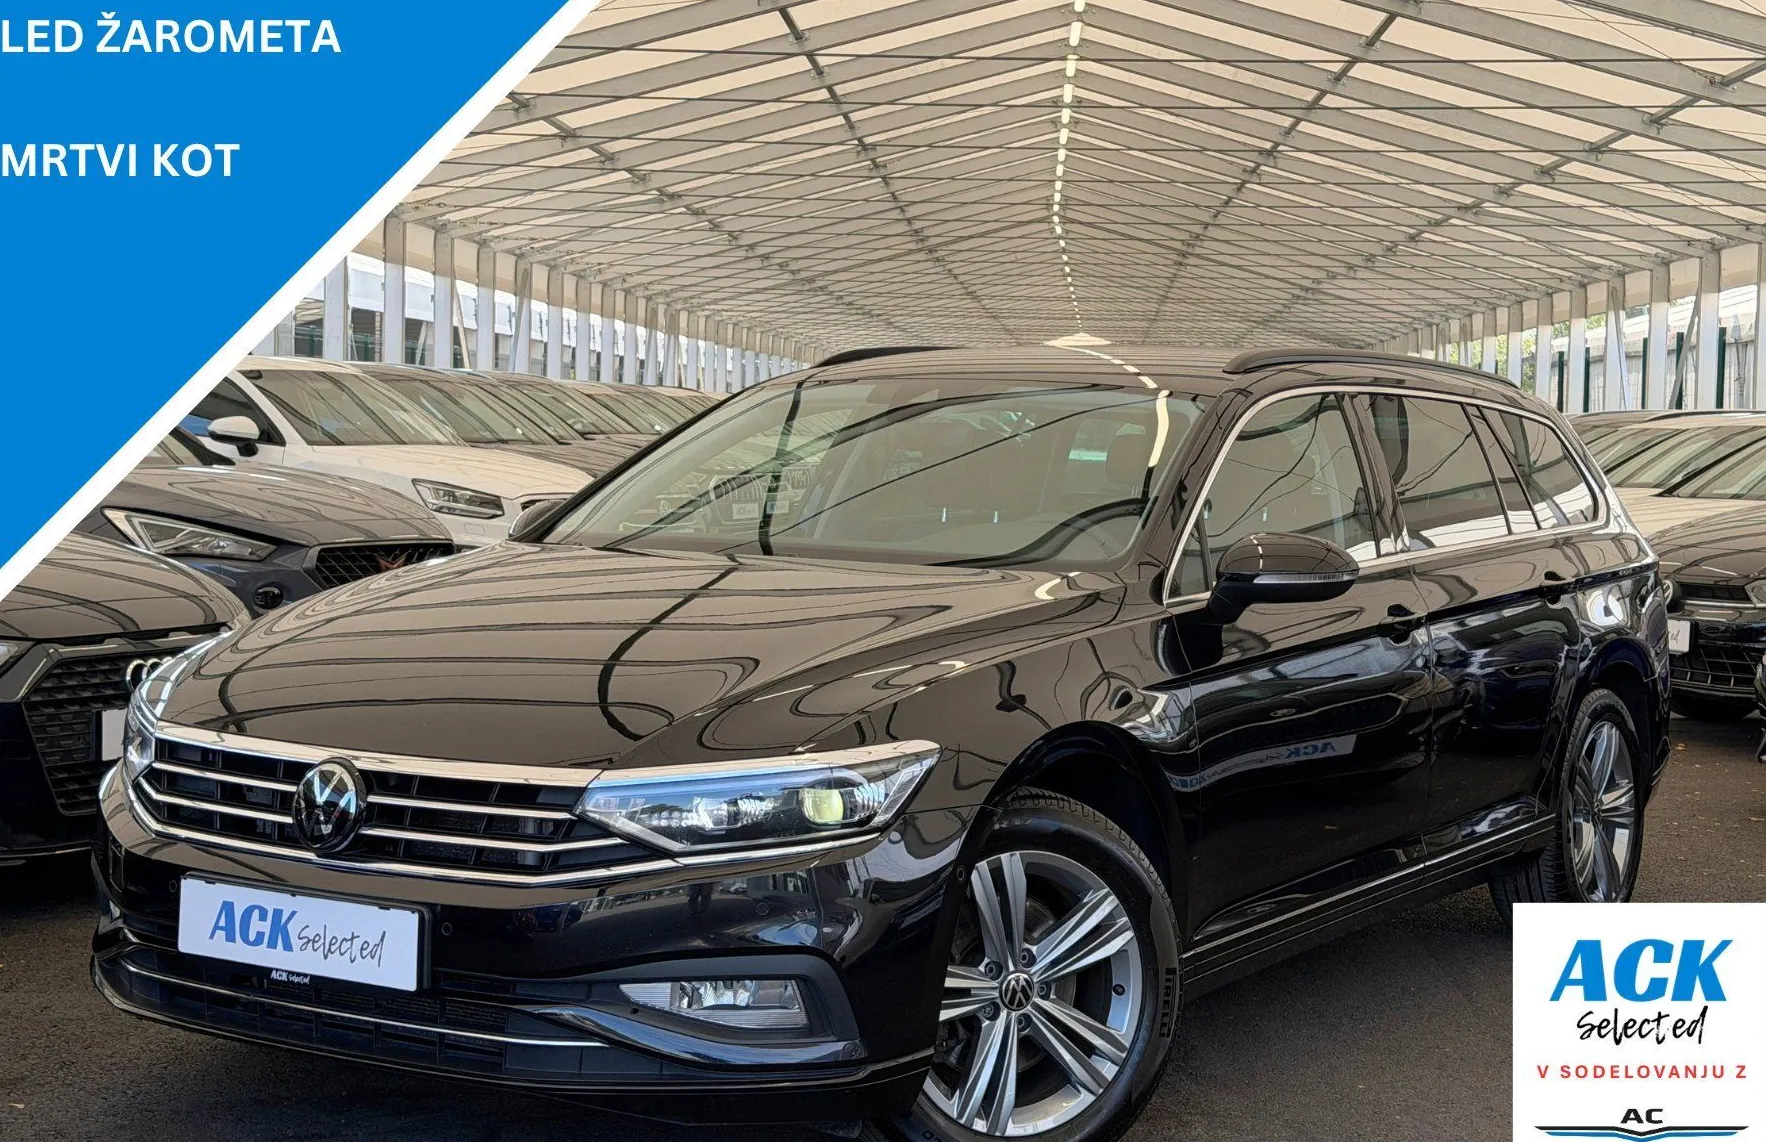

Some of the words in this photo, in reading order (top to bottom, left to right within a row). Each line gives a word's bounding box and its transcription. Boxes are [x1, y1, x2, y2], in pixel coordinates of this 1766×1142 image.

[208, 900, 298, 953] ACK
[297, 924, 387, 968] Selected
[271, 970, 288, 981] ACK
